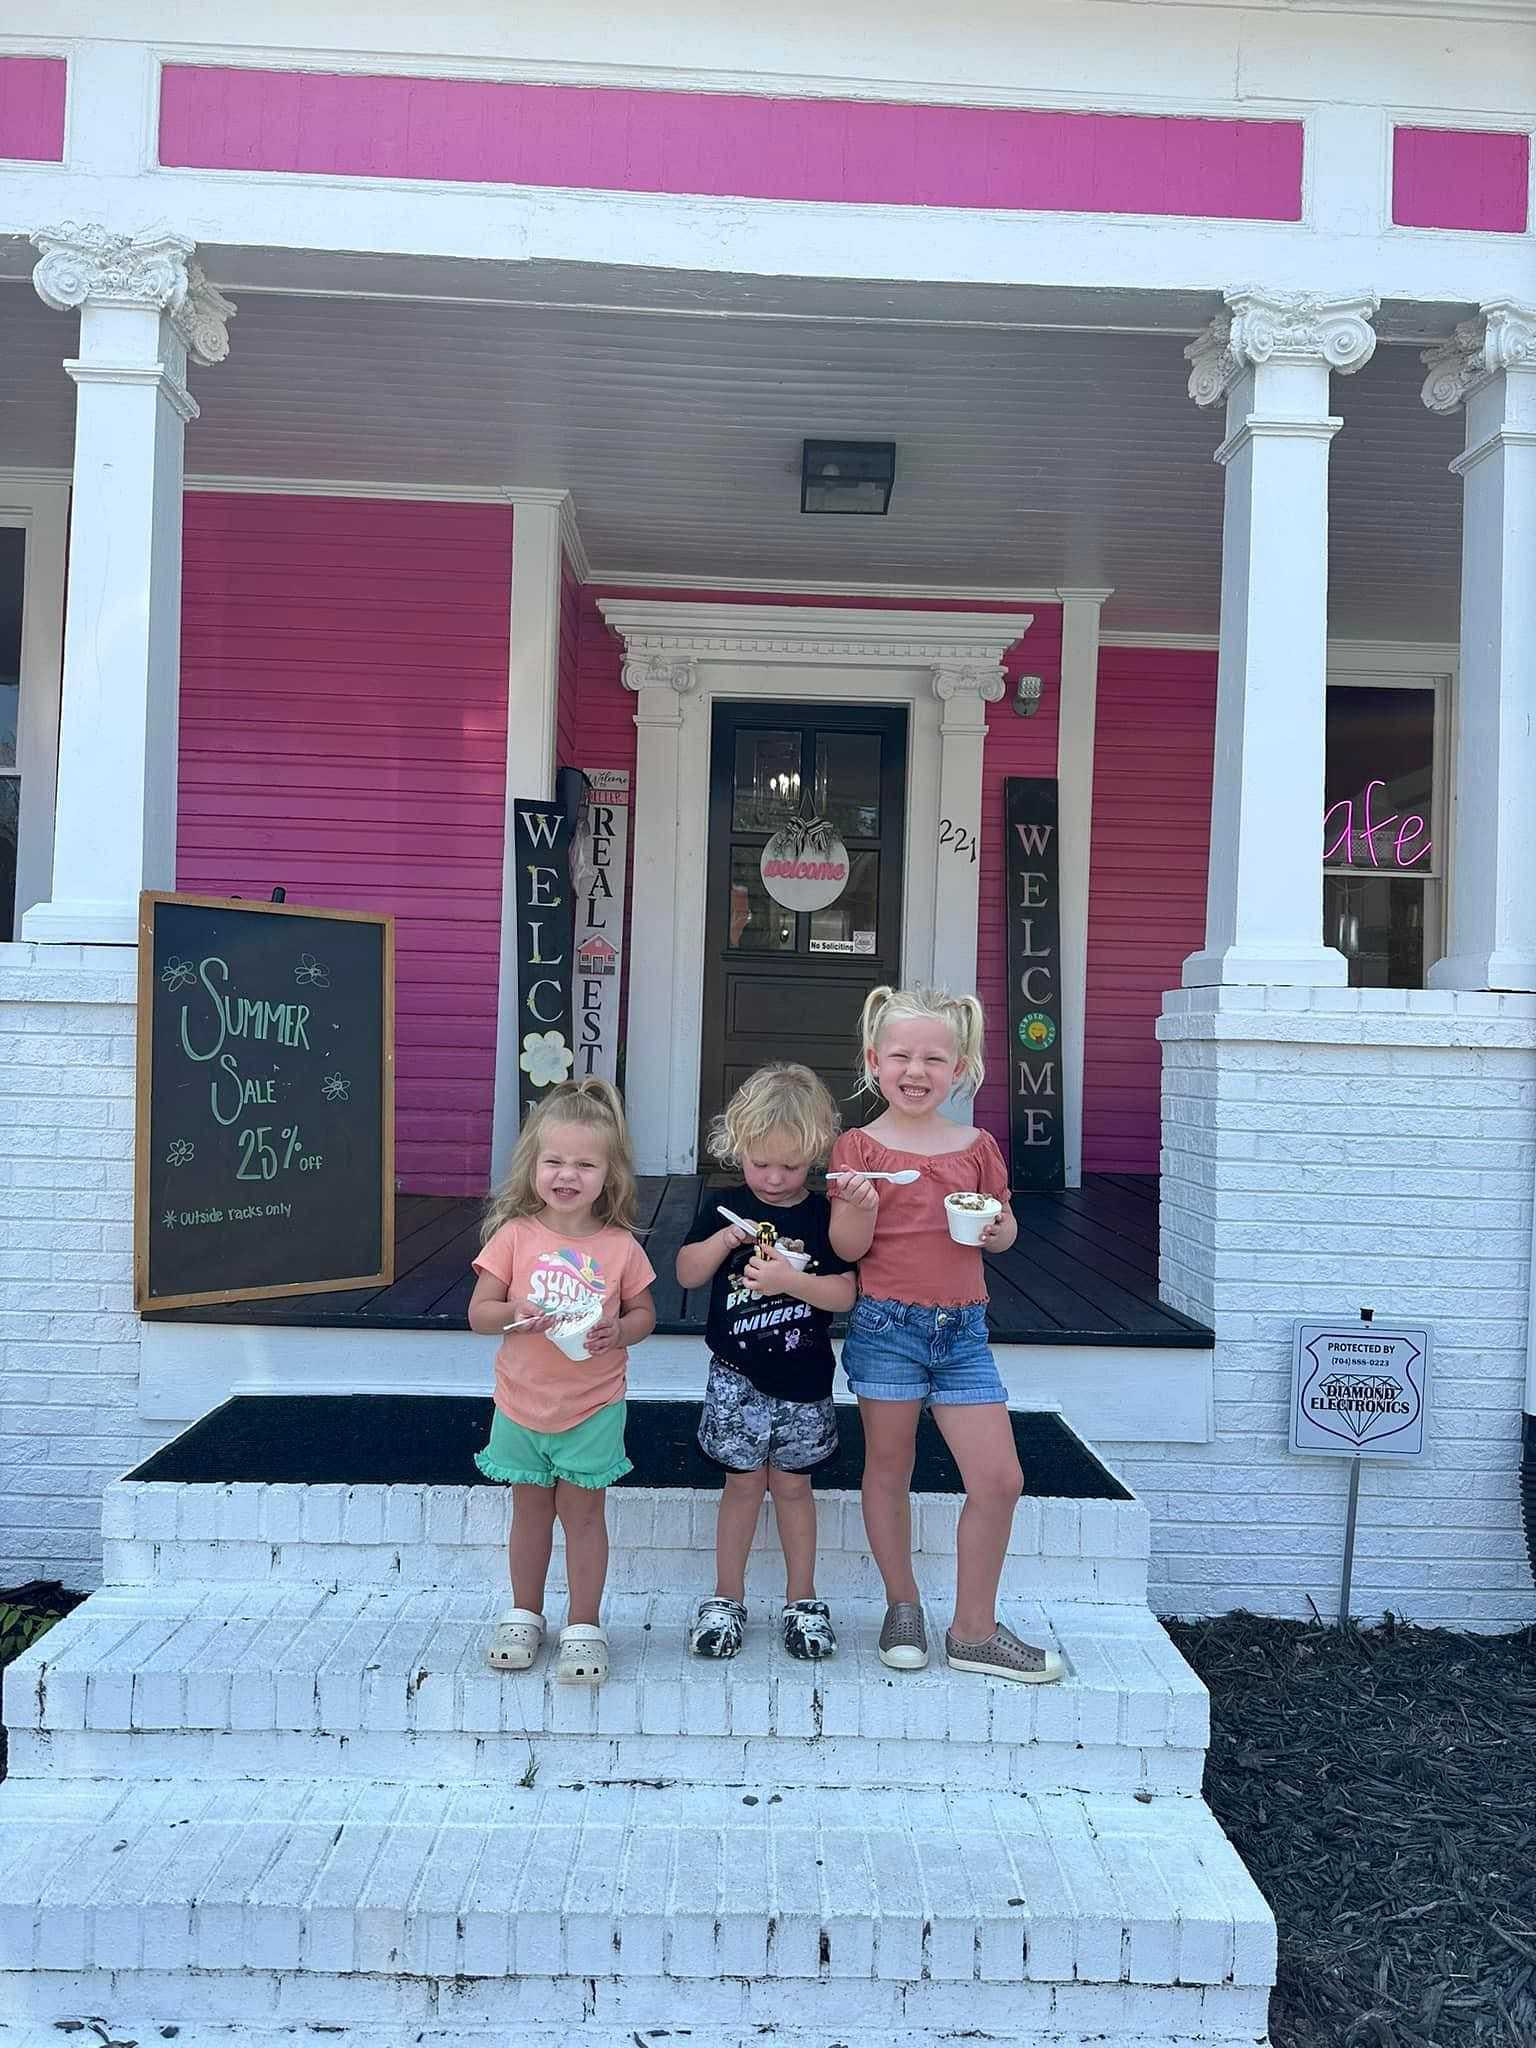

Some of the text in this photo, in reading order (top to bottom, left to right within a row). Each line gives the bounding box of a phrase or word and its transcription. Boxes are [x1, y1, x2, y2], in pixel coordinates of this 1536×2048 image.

[1321, 780, 1433, 867] afe
[938, 818, 978, 863] 221
[762, 857, 847, 881] welcome
[810, 941, 821, 950] No
[822, 942, 854, 953] Soliciting
[265, 1202, 292, 1217] only
[733, 1303, 812, 1335] UNIVERSE
[1327, 1342, 1396, 1355] PROTECTED BY
[1327, 1385, 1396, 1401] DIAMOND
[1310, 1397, 1410, 1415] ELECTRONICS
